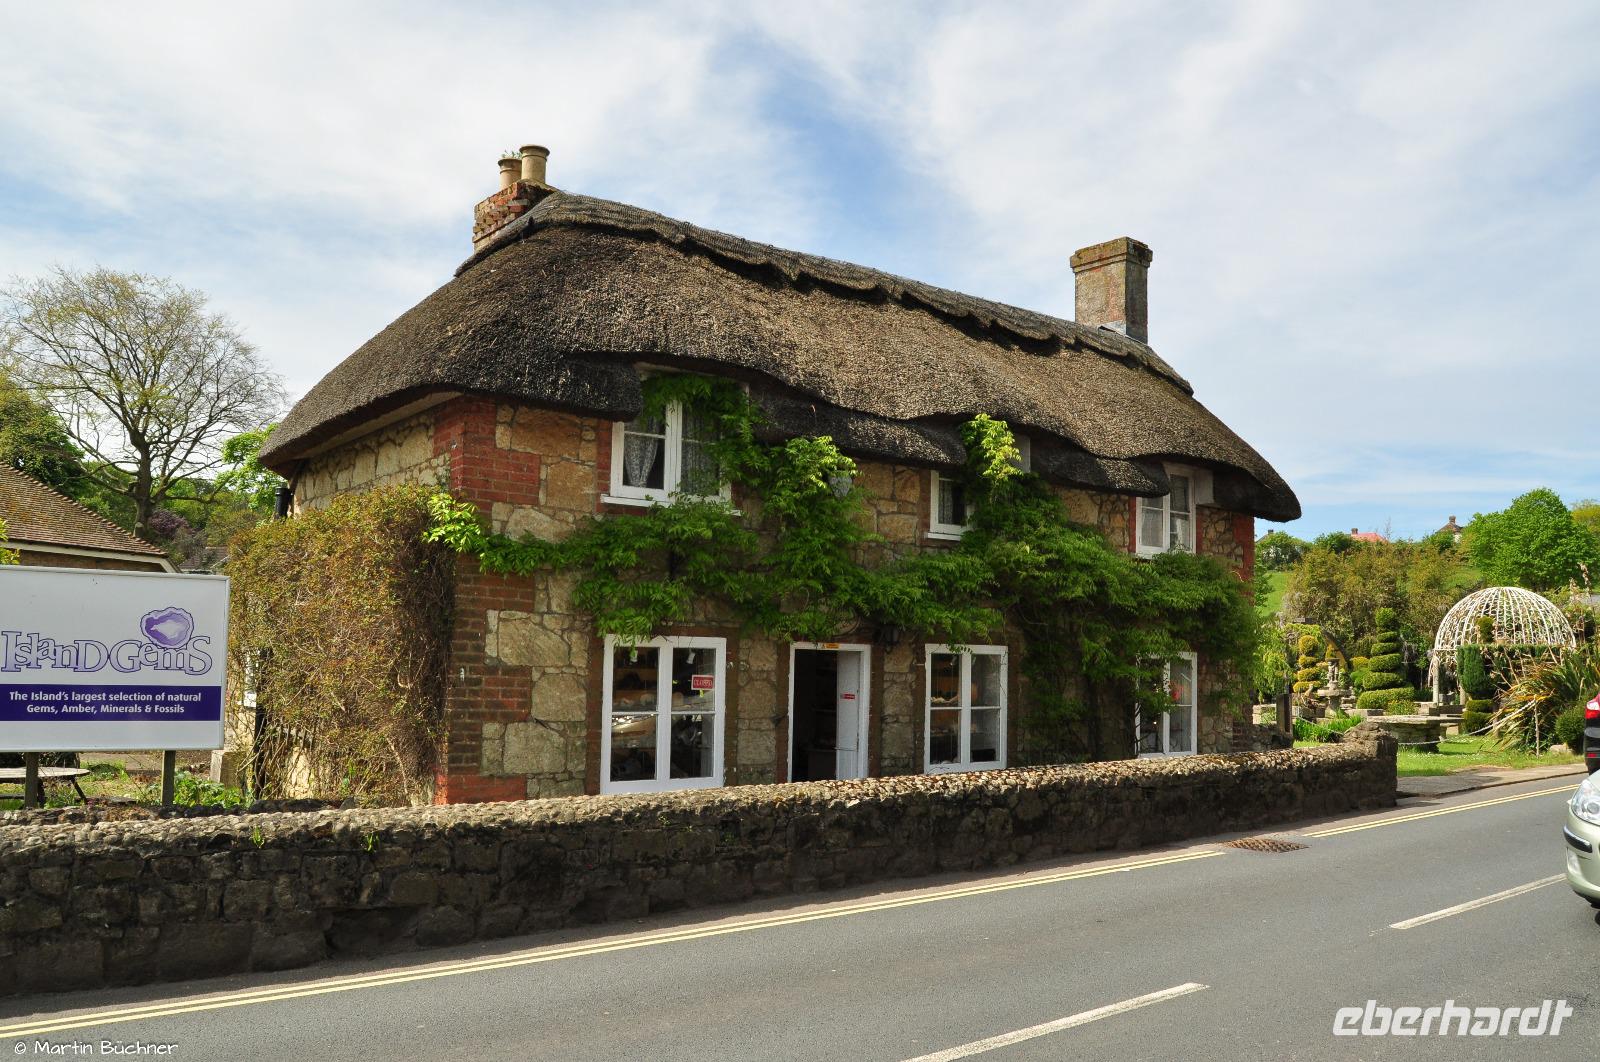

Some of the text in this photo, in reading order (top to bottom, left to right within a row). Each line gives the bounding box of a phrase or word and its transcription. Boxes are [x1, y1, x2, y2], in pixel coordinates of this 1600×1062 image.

[9, 691, 202, 703] The Island's largest selection of natural
[26, 704, 185, 714] Gems, Amber, Minerals & Fossils
